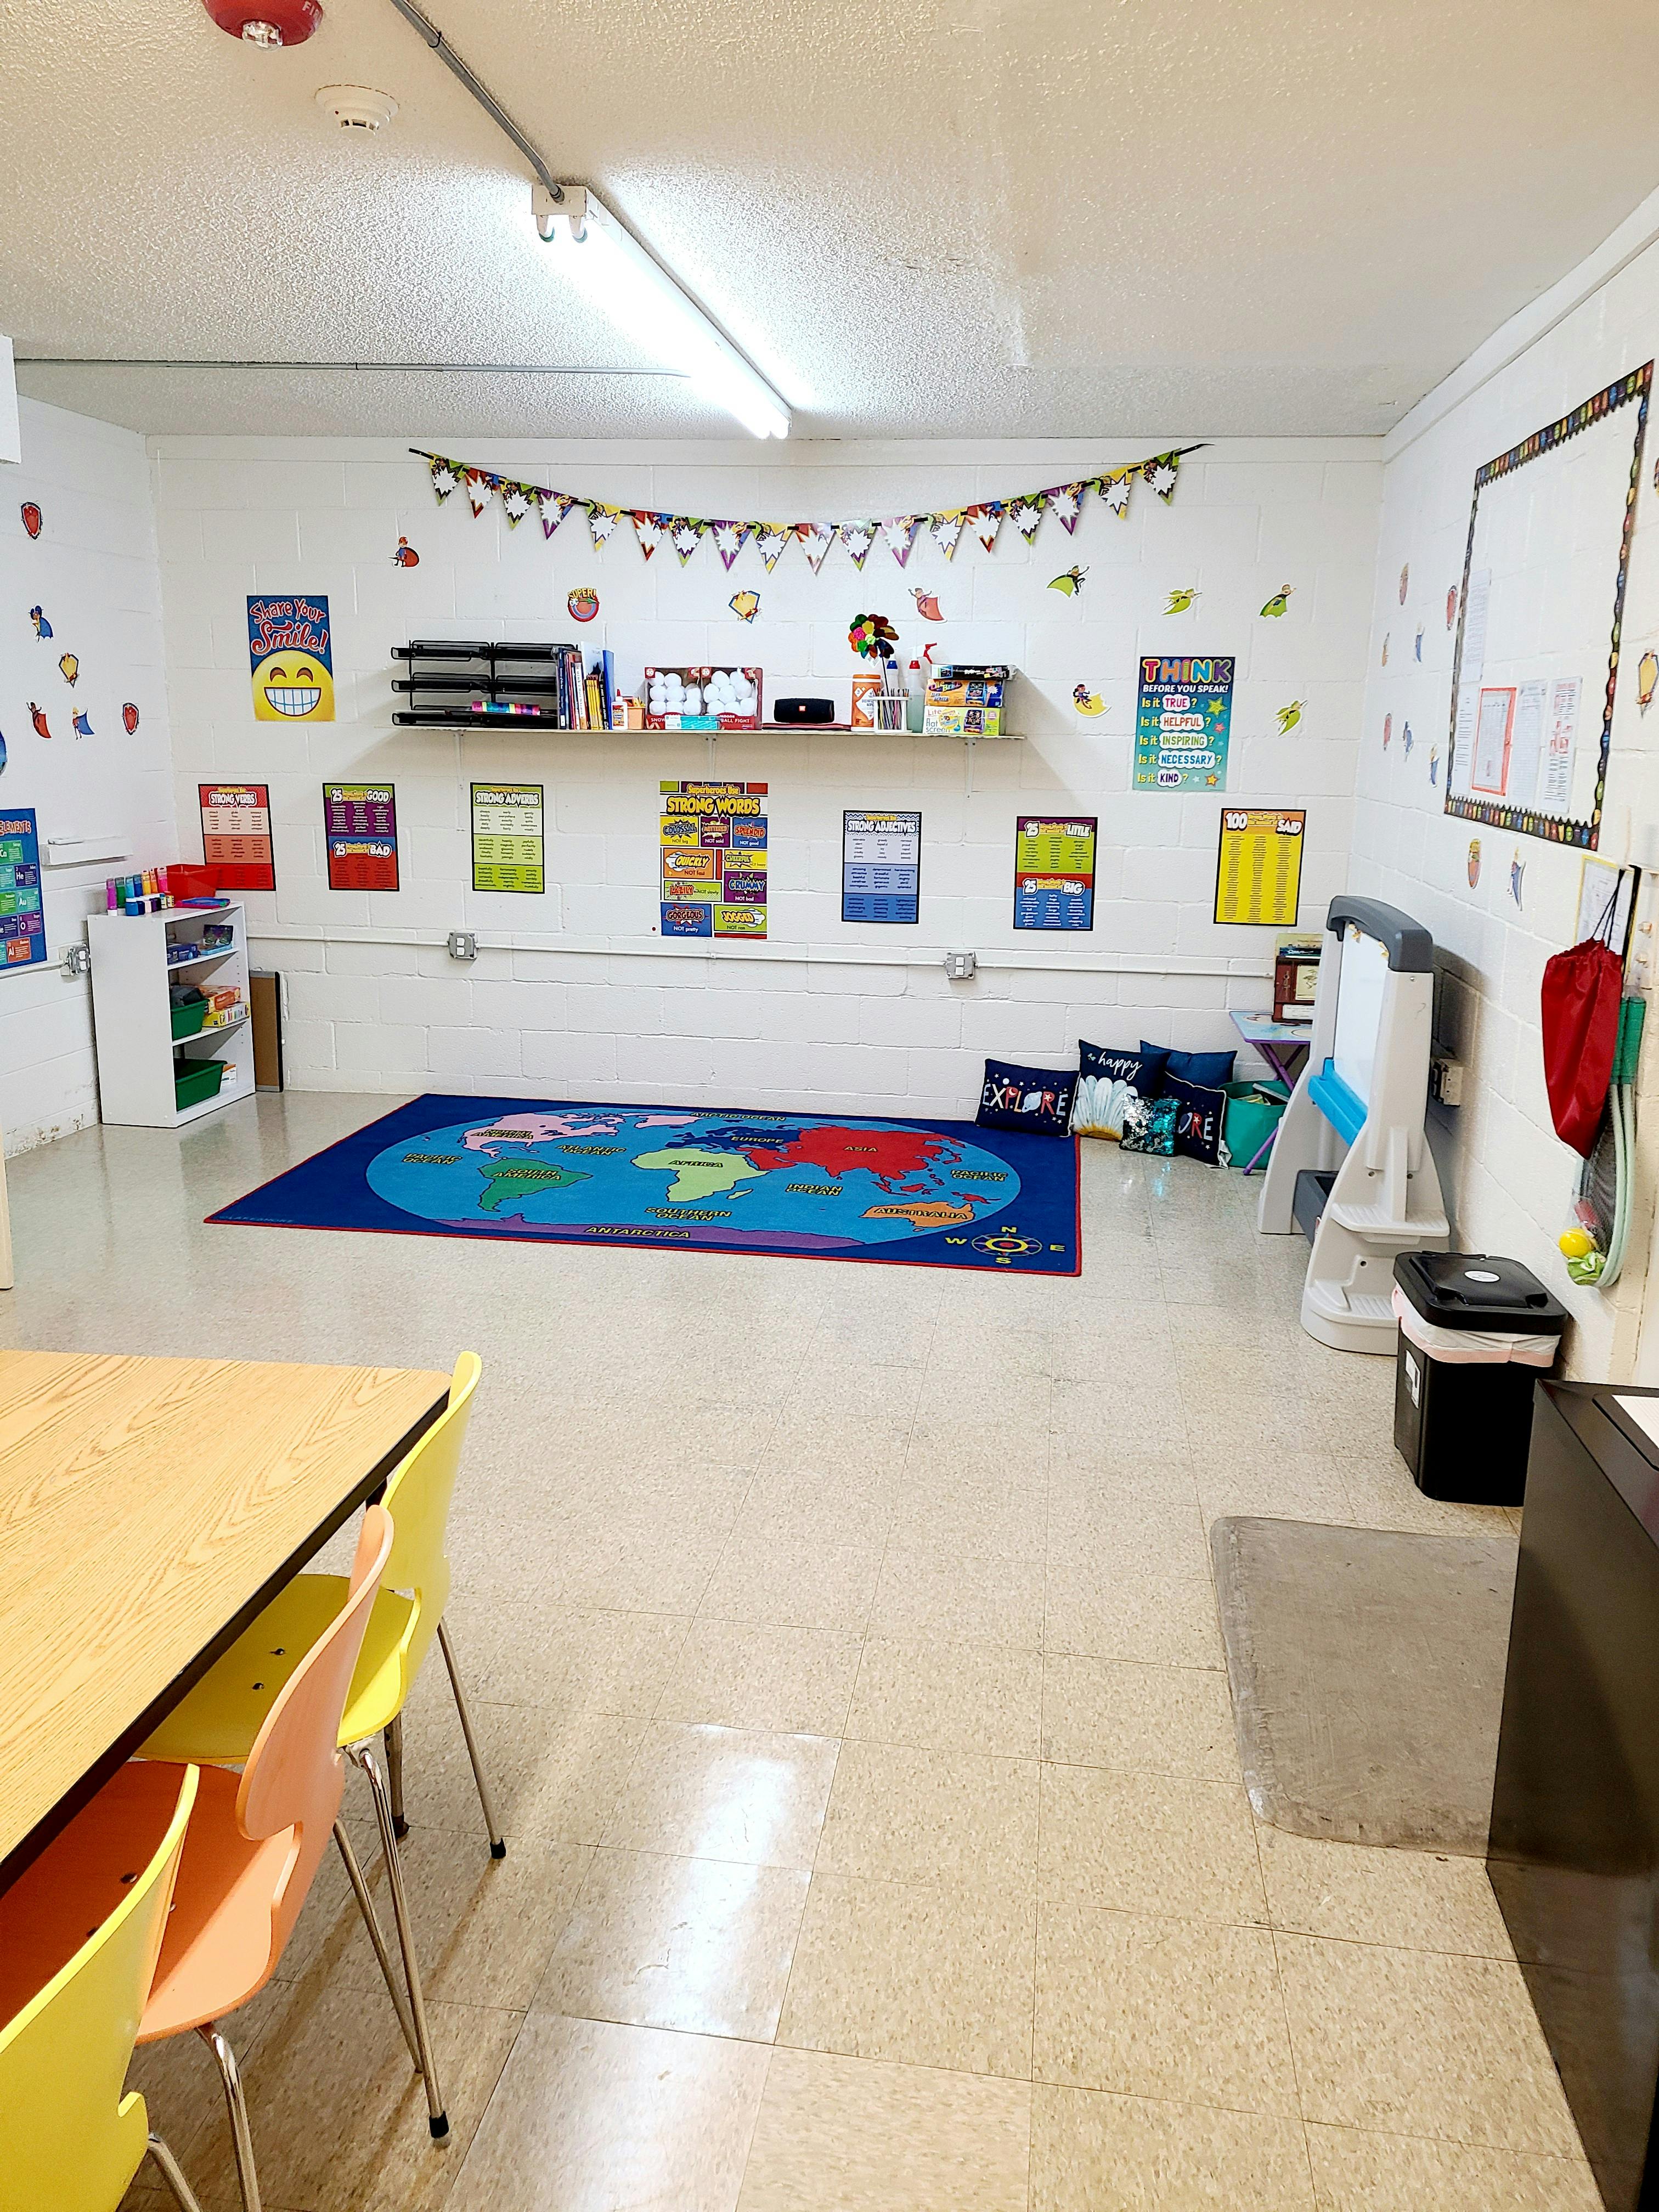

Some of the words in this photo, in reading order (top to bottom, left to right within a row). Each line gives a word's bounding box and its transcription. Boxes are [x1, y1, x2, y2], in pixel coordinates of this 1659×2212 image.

[568, 588, 597, 598] SUPER!
[250, 599, 292, 624] Share
[294, 598, 326, 623] Your
[251, 619, 329, 656] Smile!
[1142, 658, 1232, 684] THINK
[1143, 685, 1176, 693] BEFORE
[1177, 685, 1197, 693] YOU
[1197, 685, 1228, 693] SPEAK!
[1142, 698, 1151, 708] Is
[1153, 698, 1160, 708] it
[1141, 717, 1149, 726] Is
[1151, 717, 1159, 726] it
[1139, 735, 1148, 746] Is
[1150, 736, 1158, 745] it
[1138, 754, 1147, 764] Is
[1149, 754, 1156, 764] it
[1137, 774, 1147, 783] Is
[1148, 774, 1155, 782] it
[331, 789, 343, 802] 25
[366, 790, 390, 802] GOOD
[688, 785, 726, 795] Superheroes
[727, 785, 740, 795] Use
[211, 793, 235, 805] STRONG
[235, 793, 256, 806] VERBS
[476, 792, 504, 804] STRONG
[505, 793, 539, 806] ADVERBS
[667, 797, 715, 815] STRONG
[715, 796, 760, 817] WORDS
[848, 820, 874, 832] STRONG
[875, 821, 916, 833] ADJECTIVES
[1226, 812, 1248, 830] 100
[1277, 819, 1302, 834] SAID
[663, 823, 697, 836] COLOSSAL
[736, 827, 765, 837] SPLENDID
[1026, 822, 1039, 837] 25
[1066, 824, 1091, 837] LITTLE
[335, 843, 346, 856] 25
[370, 842, 391, 856] BAD
[676, 855, 710, 868] QUICKLY
[16, 872, 24, 880] He
[670, 885, 693, 895] LAZILY
[729, 879, 765, 891] CRUMMY
[1024, 879, 1037, 894] 25
[1062, 882, 1084, 895] BIG
[19, 898, 26, 906] Au
[668, 910, 703, 921] GORGEOUS
[722, 911, 755, 923] JOGGED
[1098, 1052, 1143, 1081] happy
[982, 1083, 1069, 1116] EXPLORE
[645, 1207, 732, 1216] SOUTHERN
[874, 1207, 968, 1219] AUSTRALIA
[586, 1226, 690, 1238] ANTARCTICA
